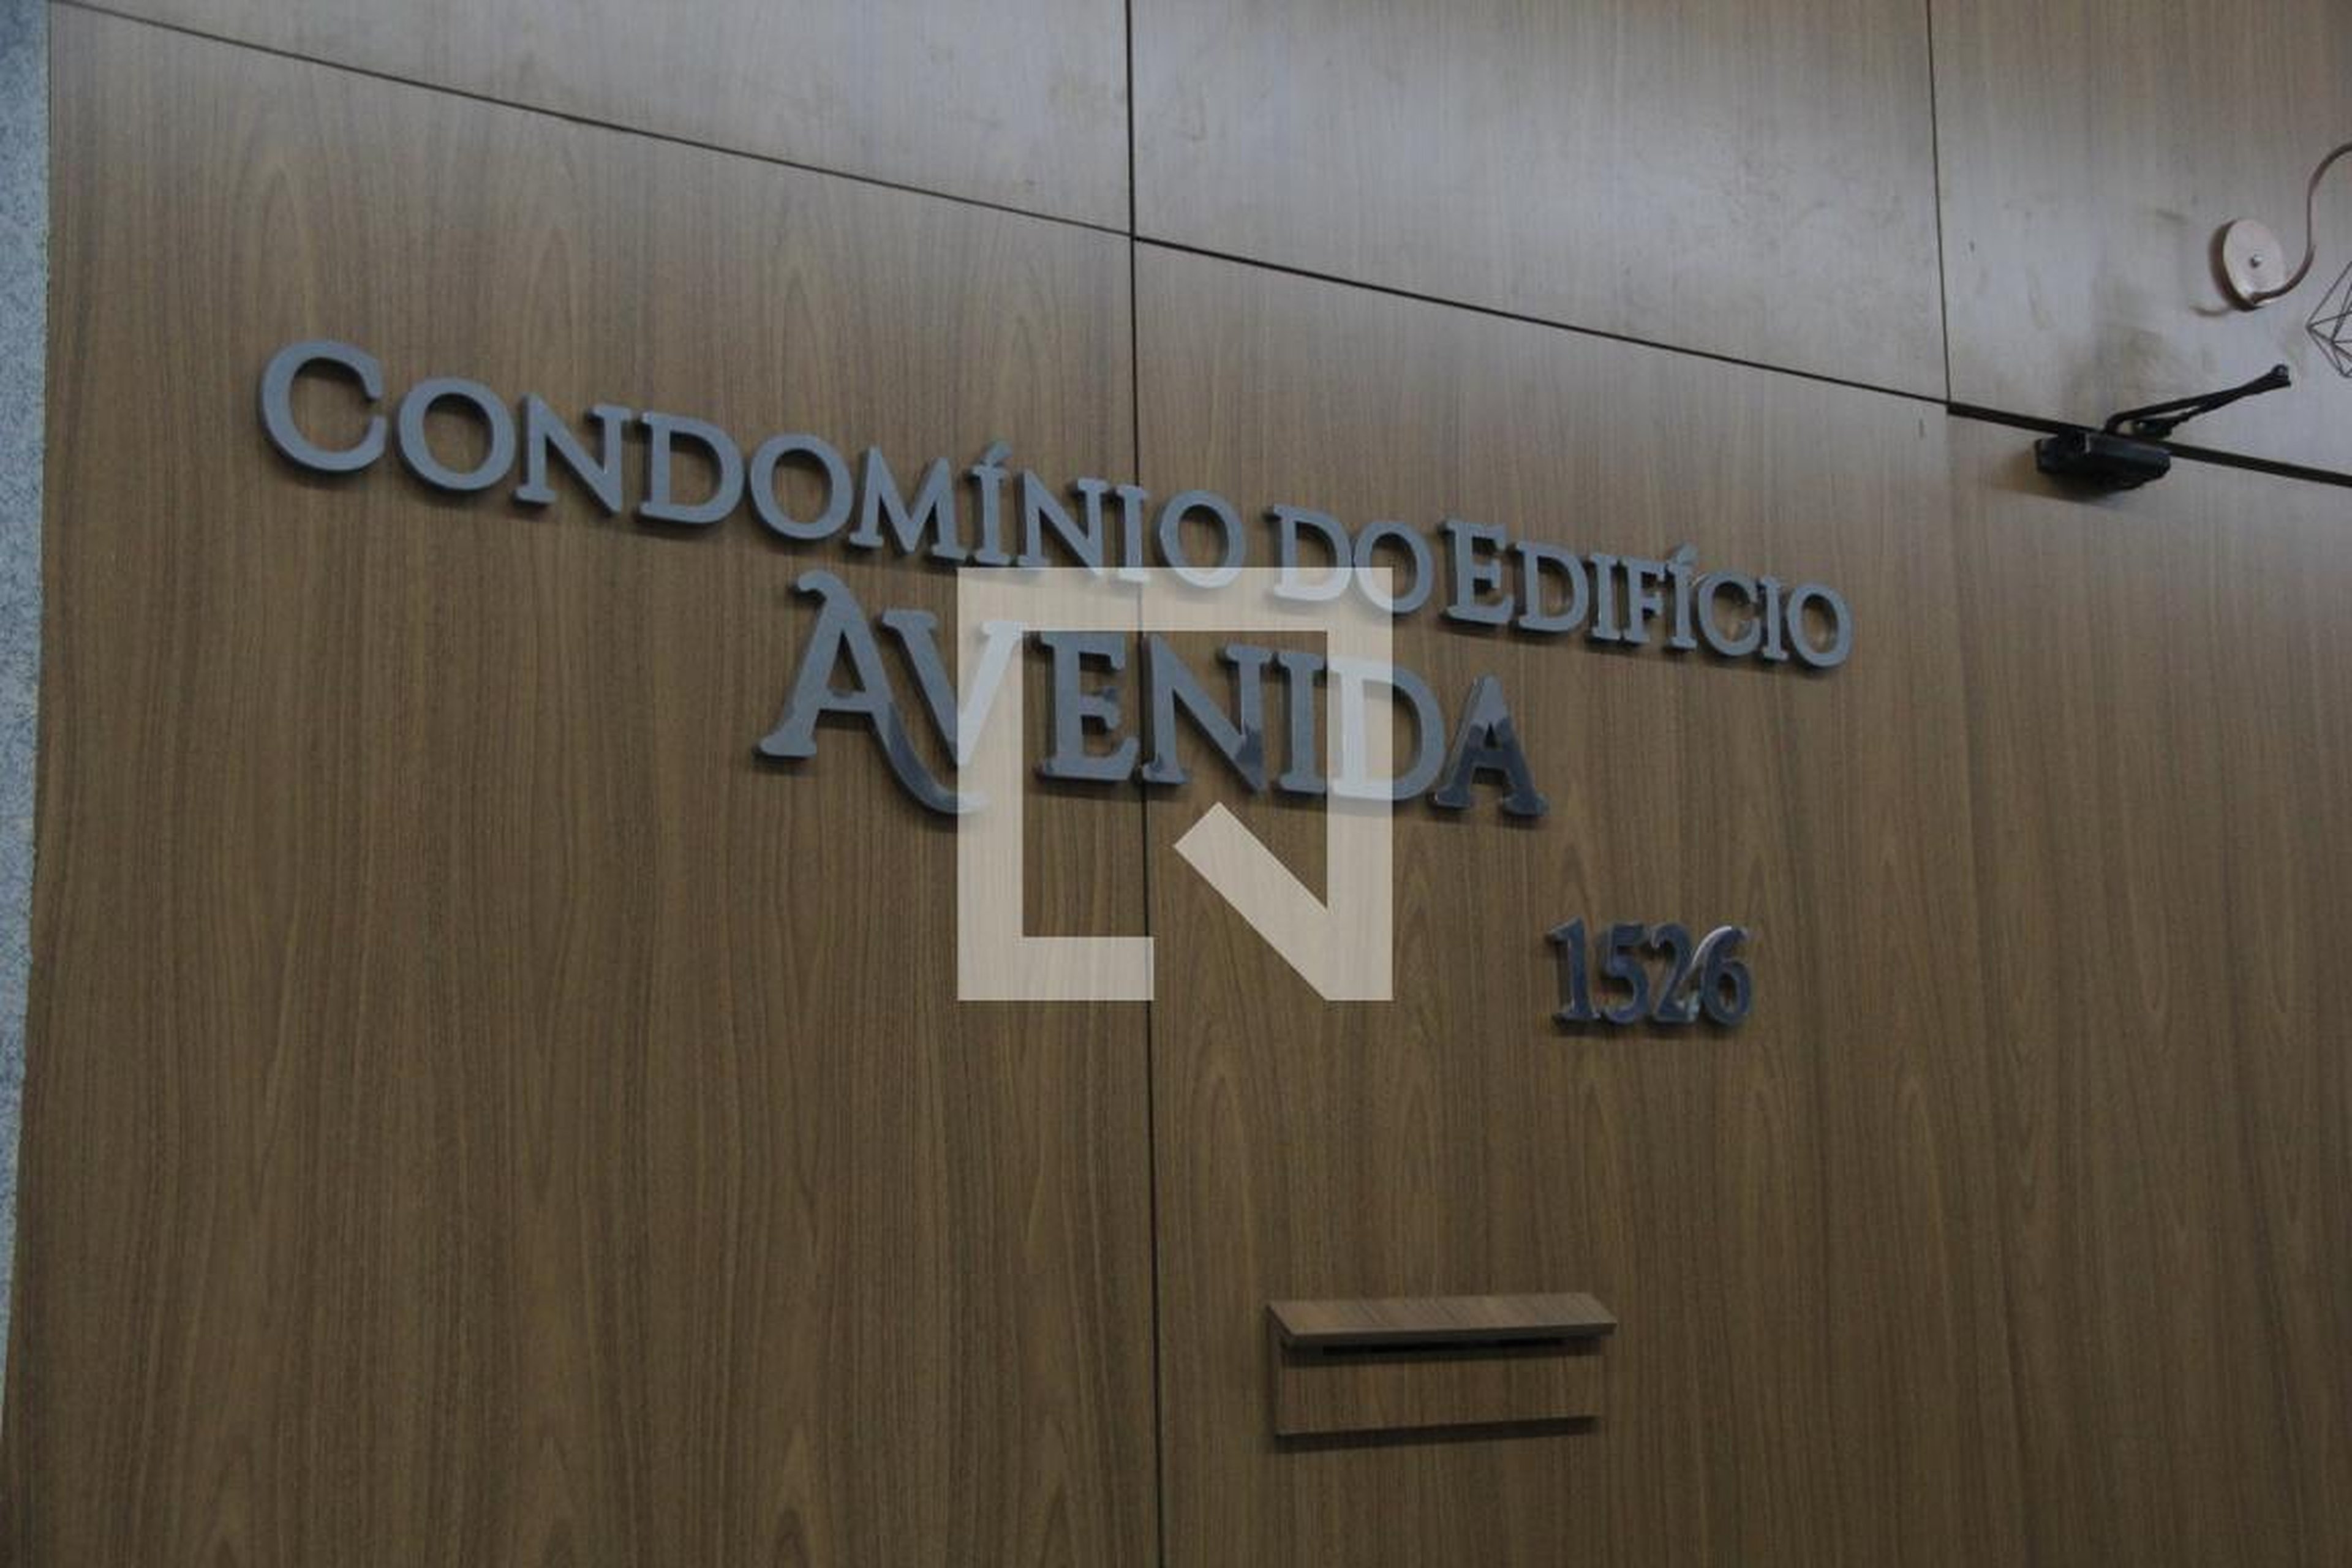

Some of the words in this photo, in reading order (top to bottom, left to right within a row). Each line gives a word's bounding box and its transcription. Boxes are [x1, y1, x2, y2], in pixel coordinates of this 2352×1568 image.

[259, 338, 1247, 589] CONDOMÍNIO
[1270, 503, 1434, 615] DO
[1441, 519, 1853, 668] EDIFÍCIO
[753, 569, 1548, 816] AVENIDA
[1545, 918, 1753, 1026] 1526
